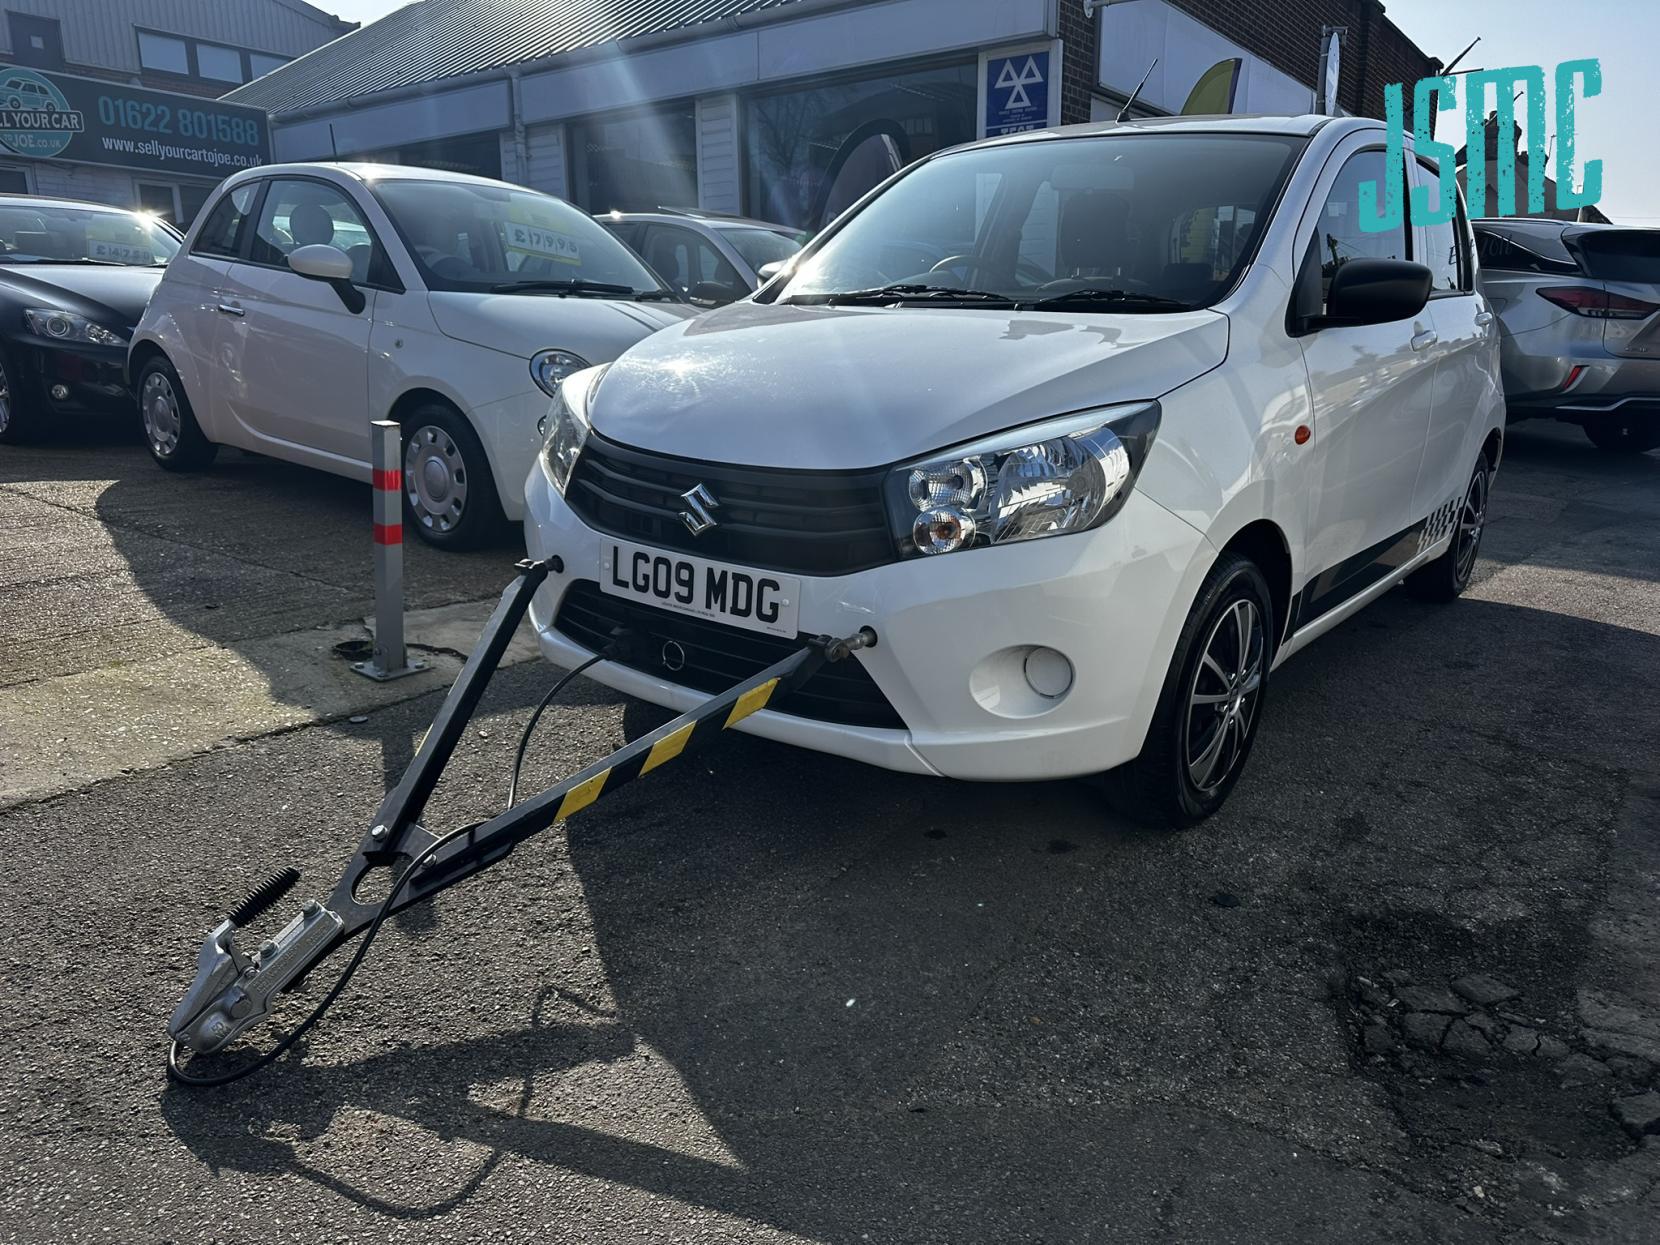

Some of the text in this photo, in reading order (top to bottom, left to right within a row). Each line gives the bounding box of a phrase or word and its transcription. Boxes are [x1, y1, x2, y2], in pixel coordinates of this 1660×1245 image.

[12, 112, 50, 128] YOUR
[51, 113, 79, 129] CAR
[98, 96, 259, 146] 01622 801588
[102, 137, 262, 168] www.sellyourcartojoe.co.uk
[612, 546, 780, 624] LG09 MDG
